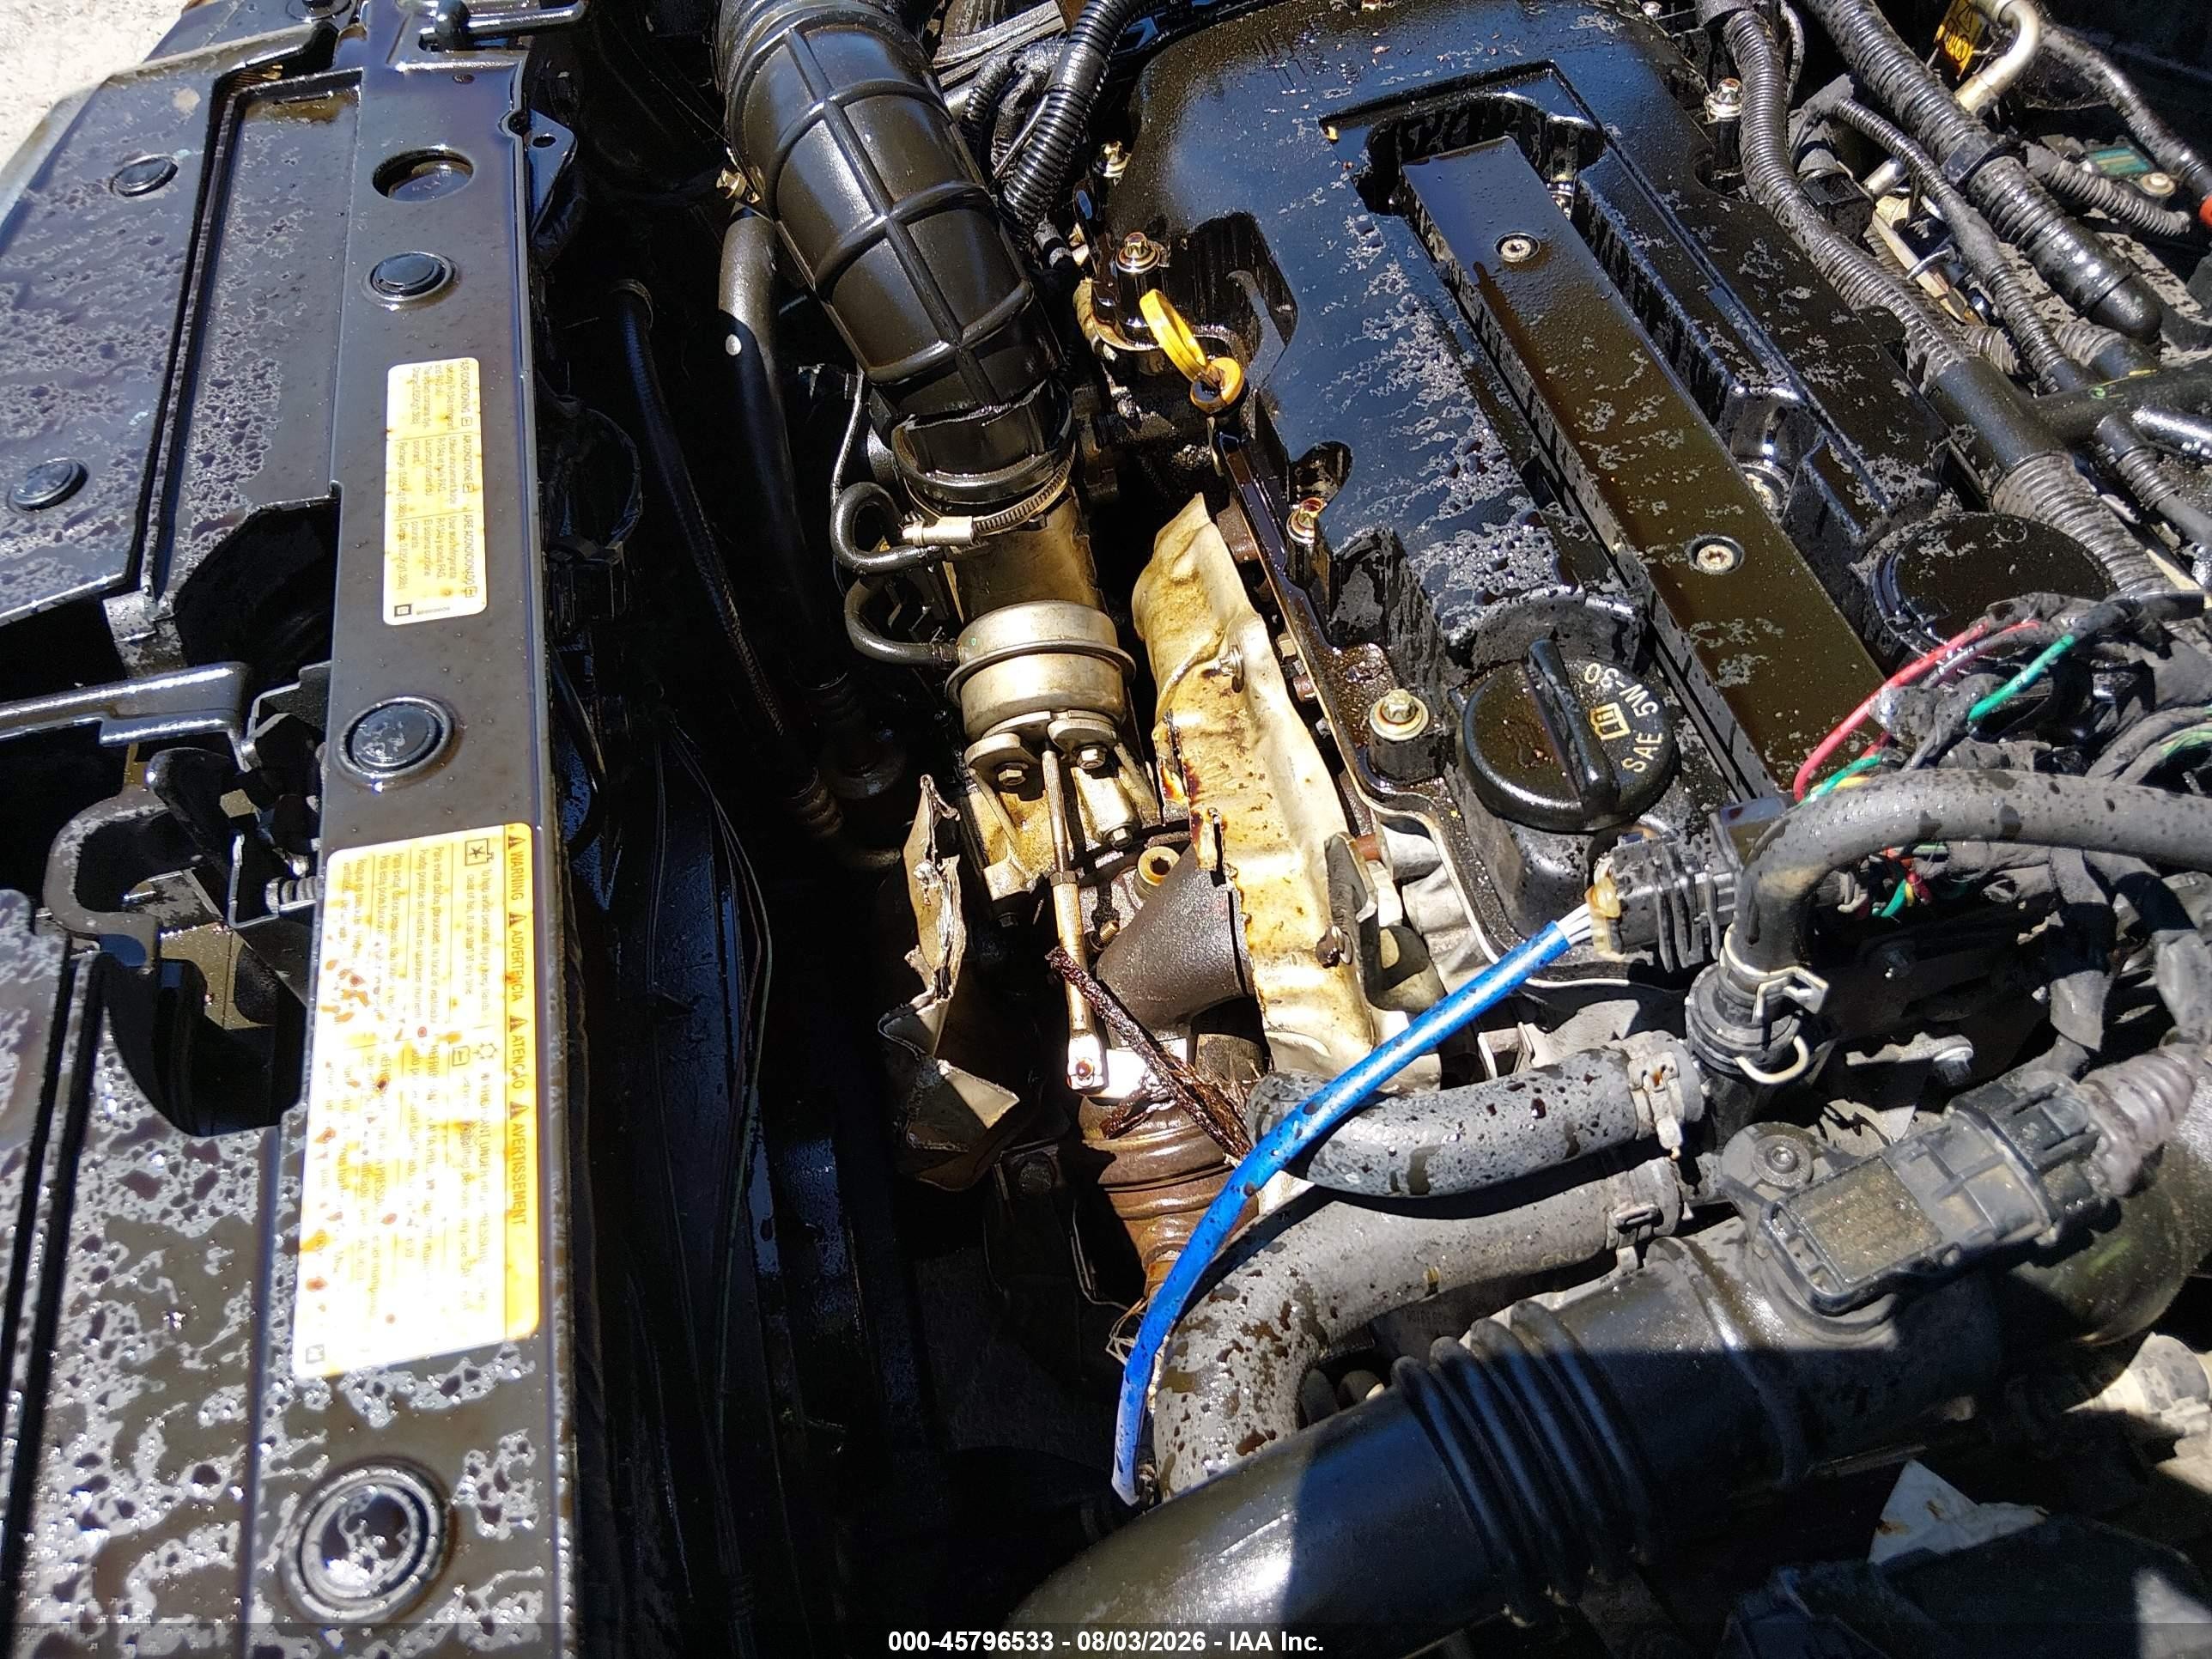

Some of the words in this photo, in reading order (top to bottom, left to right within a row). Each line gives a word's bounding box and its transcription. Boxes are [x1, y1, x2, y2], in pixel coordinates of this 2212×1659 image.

[1584, 663, 1658, 717] 5W-30
[1621, 732, 1663, 773] SAE
[510, 850, 524, 901] WARNING
[510, 928, 525, 1002] ADVERTENCIA
[509, 1033, 528, 1090] ATENÇÃO
[511, 1121, 526, 1227] AVERTISSEMENT
